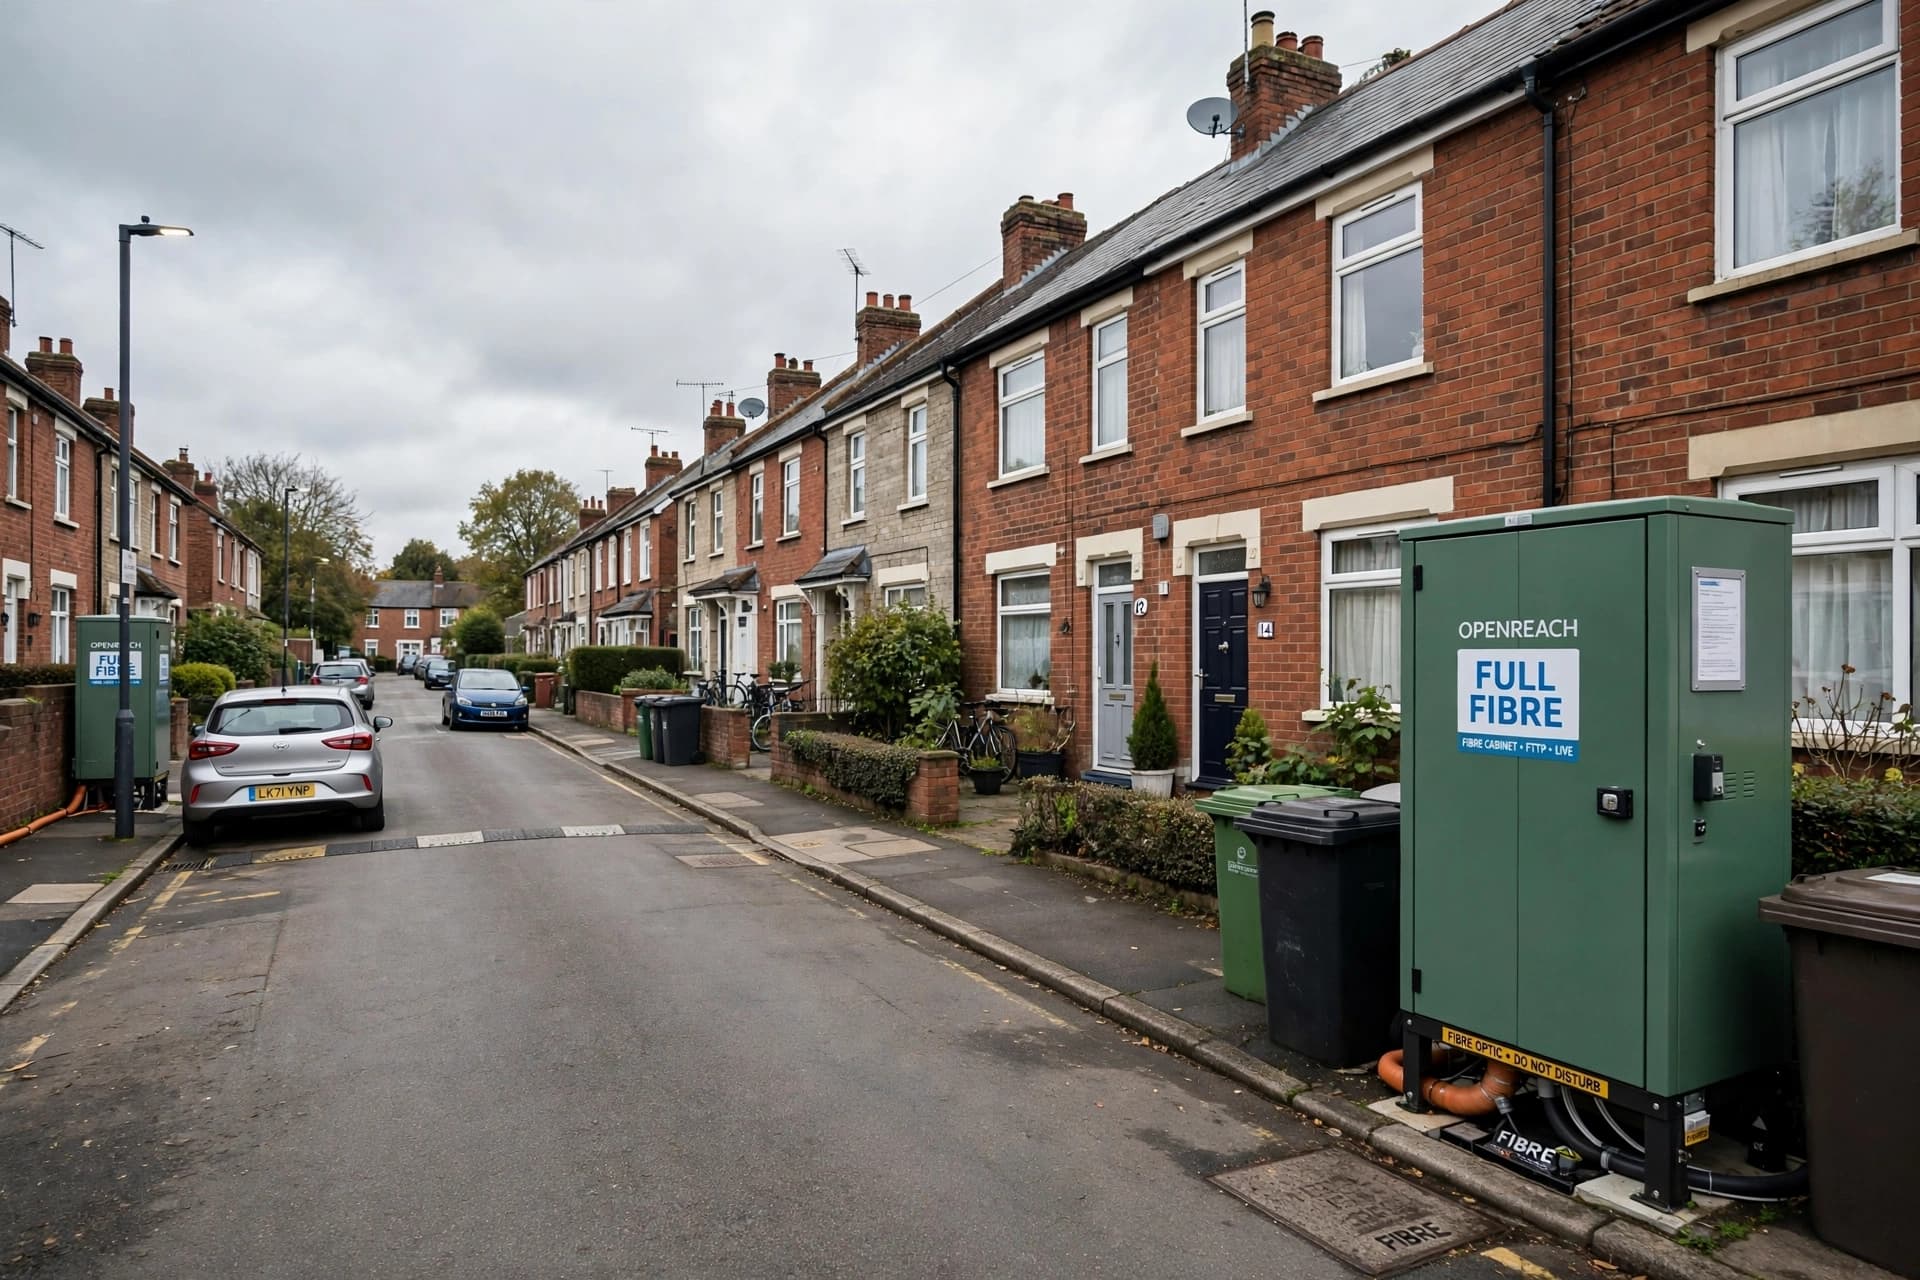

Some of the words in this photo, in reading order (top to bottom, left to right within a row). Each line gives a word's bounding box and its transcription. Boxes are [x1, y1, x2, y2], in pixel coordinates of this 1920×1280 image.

[1261, 624, 1271, 636] 14
[1458, 619, 1578, 639] OPENREACH
[90, 641, 141, 649] OPENRCH
[96, 666, 137, 676] FIBE
[1476, 660, 1556, 692] FULL
[1470, 694, 1563, 728] FIBRE
[1462, 737, 1483, 749] FIBRE
[1484, 739, 1518, 752] CABINET
[1526, 742, 1547, 754] FTTP
[1555, 745, 1574, 757] LIVE
[258, 787, 285, 799] LK71
[287, 785, 310, 797] YNP
[1447, 1031, 1473, 1049] FIBRE
[1475, 1040, 1503, 1059] OPTIC
[1514, 1053, 1528, 1068] DO
[1530, 1059, 1552, 1075] NOT
[1555, 1067, 1601, 1093] DISTURB
[1496, 1129, 1557, 1164] FIBRE
[1374, 1221, 1452, 1252] FIBRE
